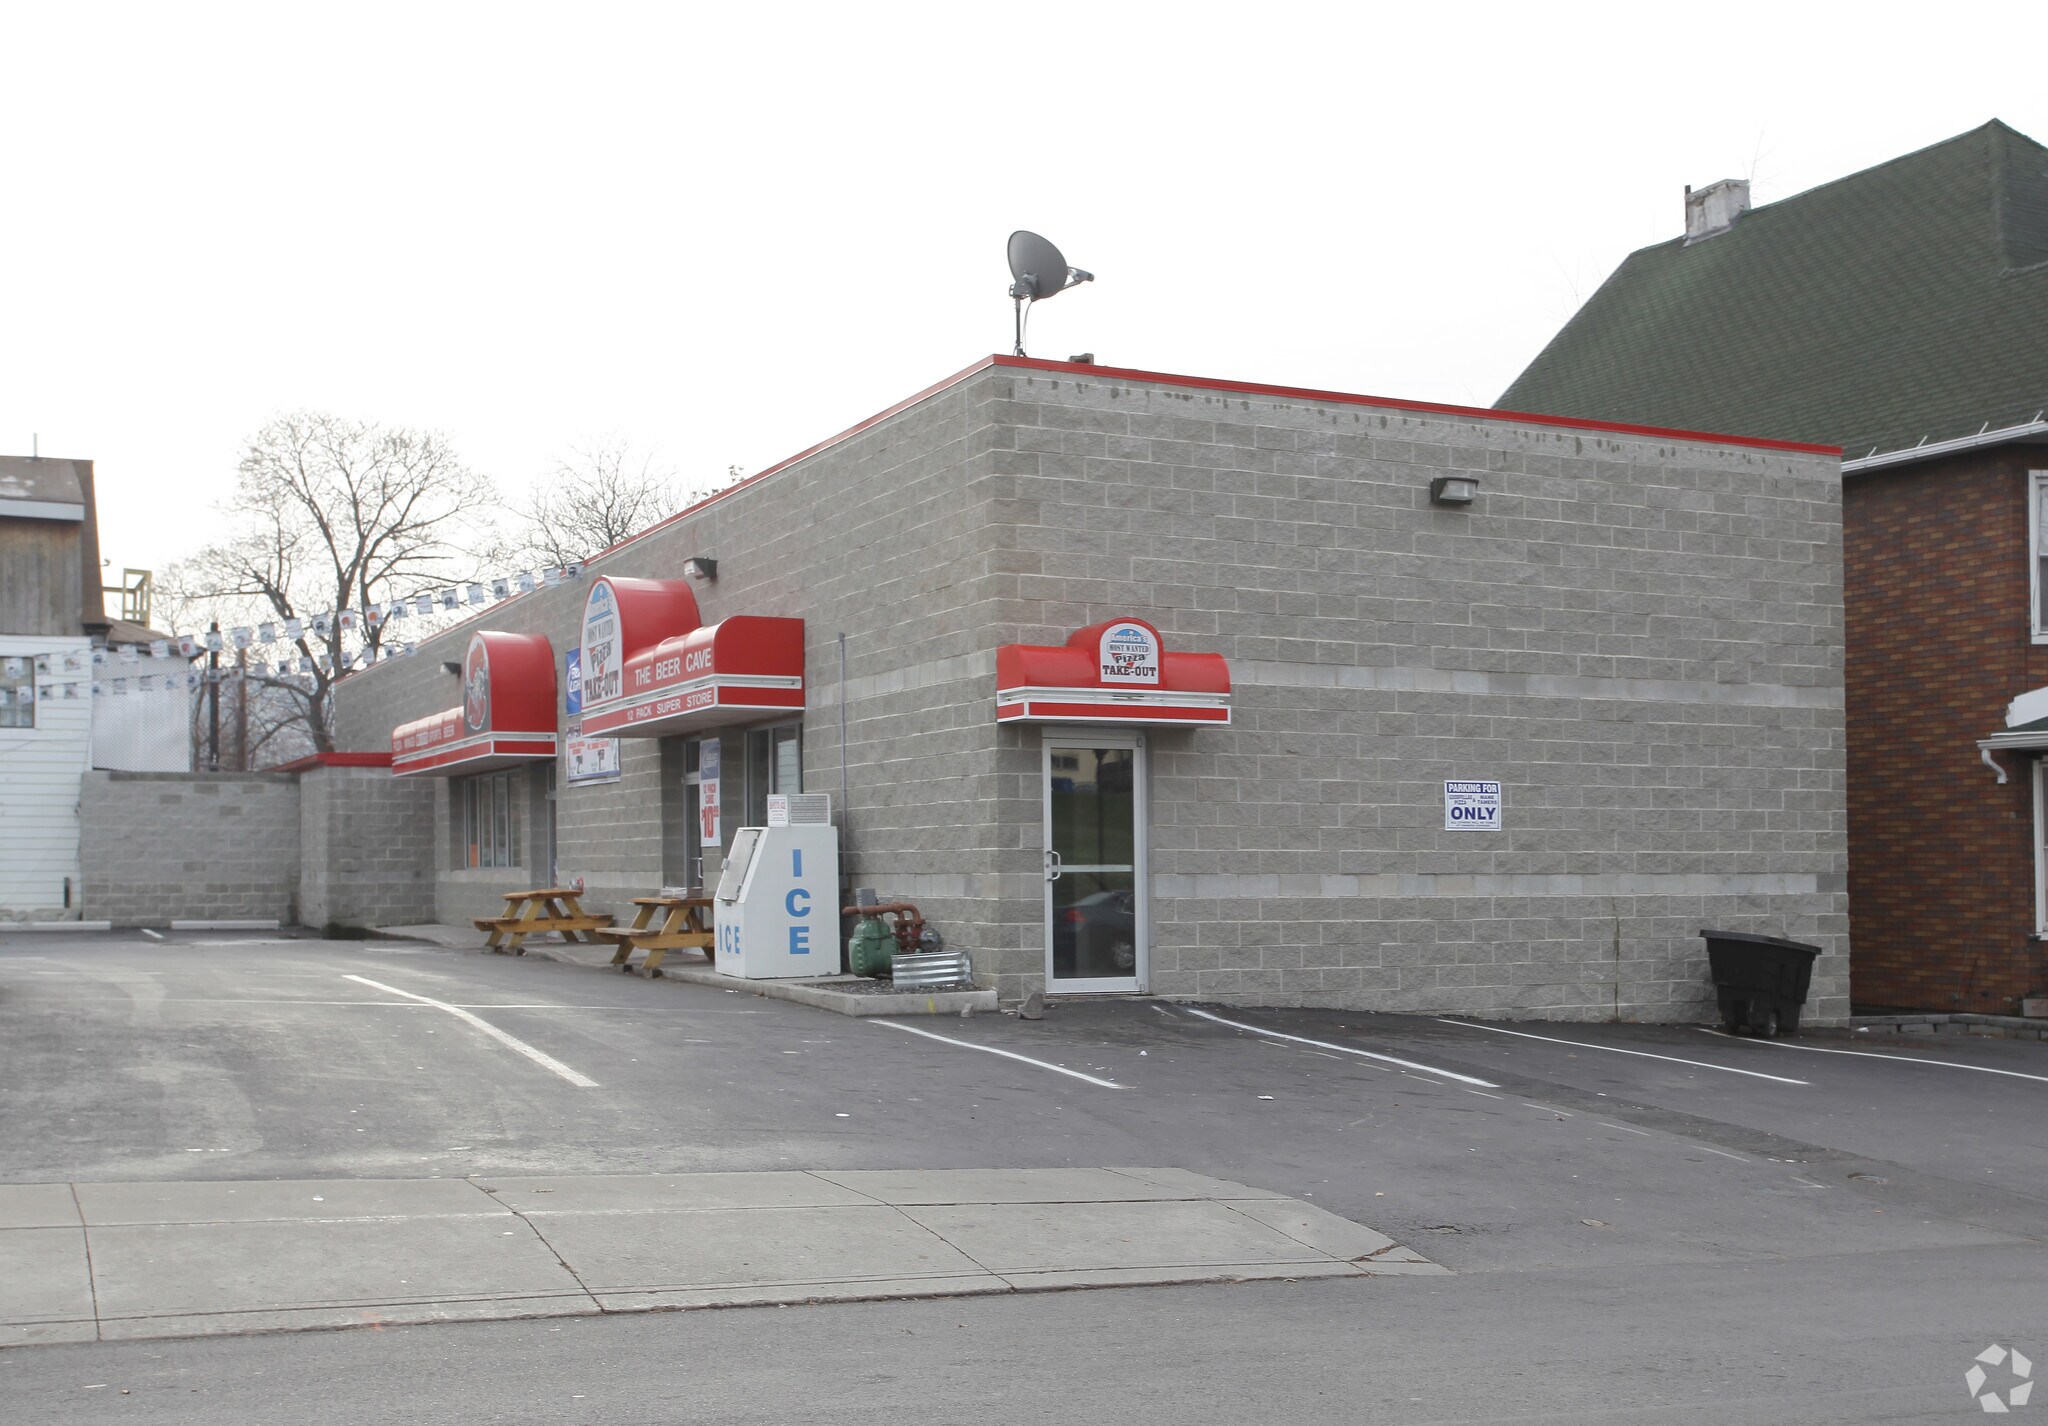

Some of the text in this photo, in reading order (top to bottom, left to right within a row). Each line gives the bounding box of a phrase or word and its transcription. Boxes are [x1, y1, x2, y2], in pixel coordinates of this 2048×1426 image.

[1110, 632, 1148, 643] America's
[1109, 644, 1149, 653] MOST WANTED
[591, 641, 611, 671] Pizza
[1116, 654, 1145, 664] Pizza
[635, 647, 712, 686] THE BEER CAVE
[1102, 665, 1157, 677] TAKE-OUT
[584, 669, 619, 703] TAKE-OUT
[627, 690, 713, 720] 12 PACK SUPER STORE
[443, 724, 454, 738] BEER
[1448, 783, 1497, 792] PARKING FOR
[1451, 807, 1496, 820] ONLY
[785, 849, 812, 955] ICE
[719, 923, 741, 954] ICE
